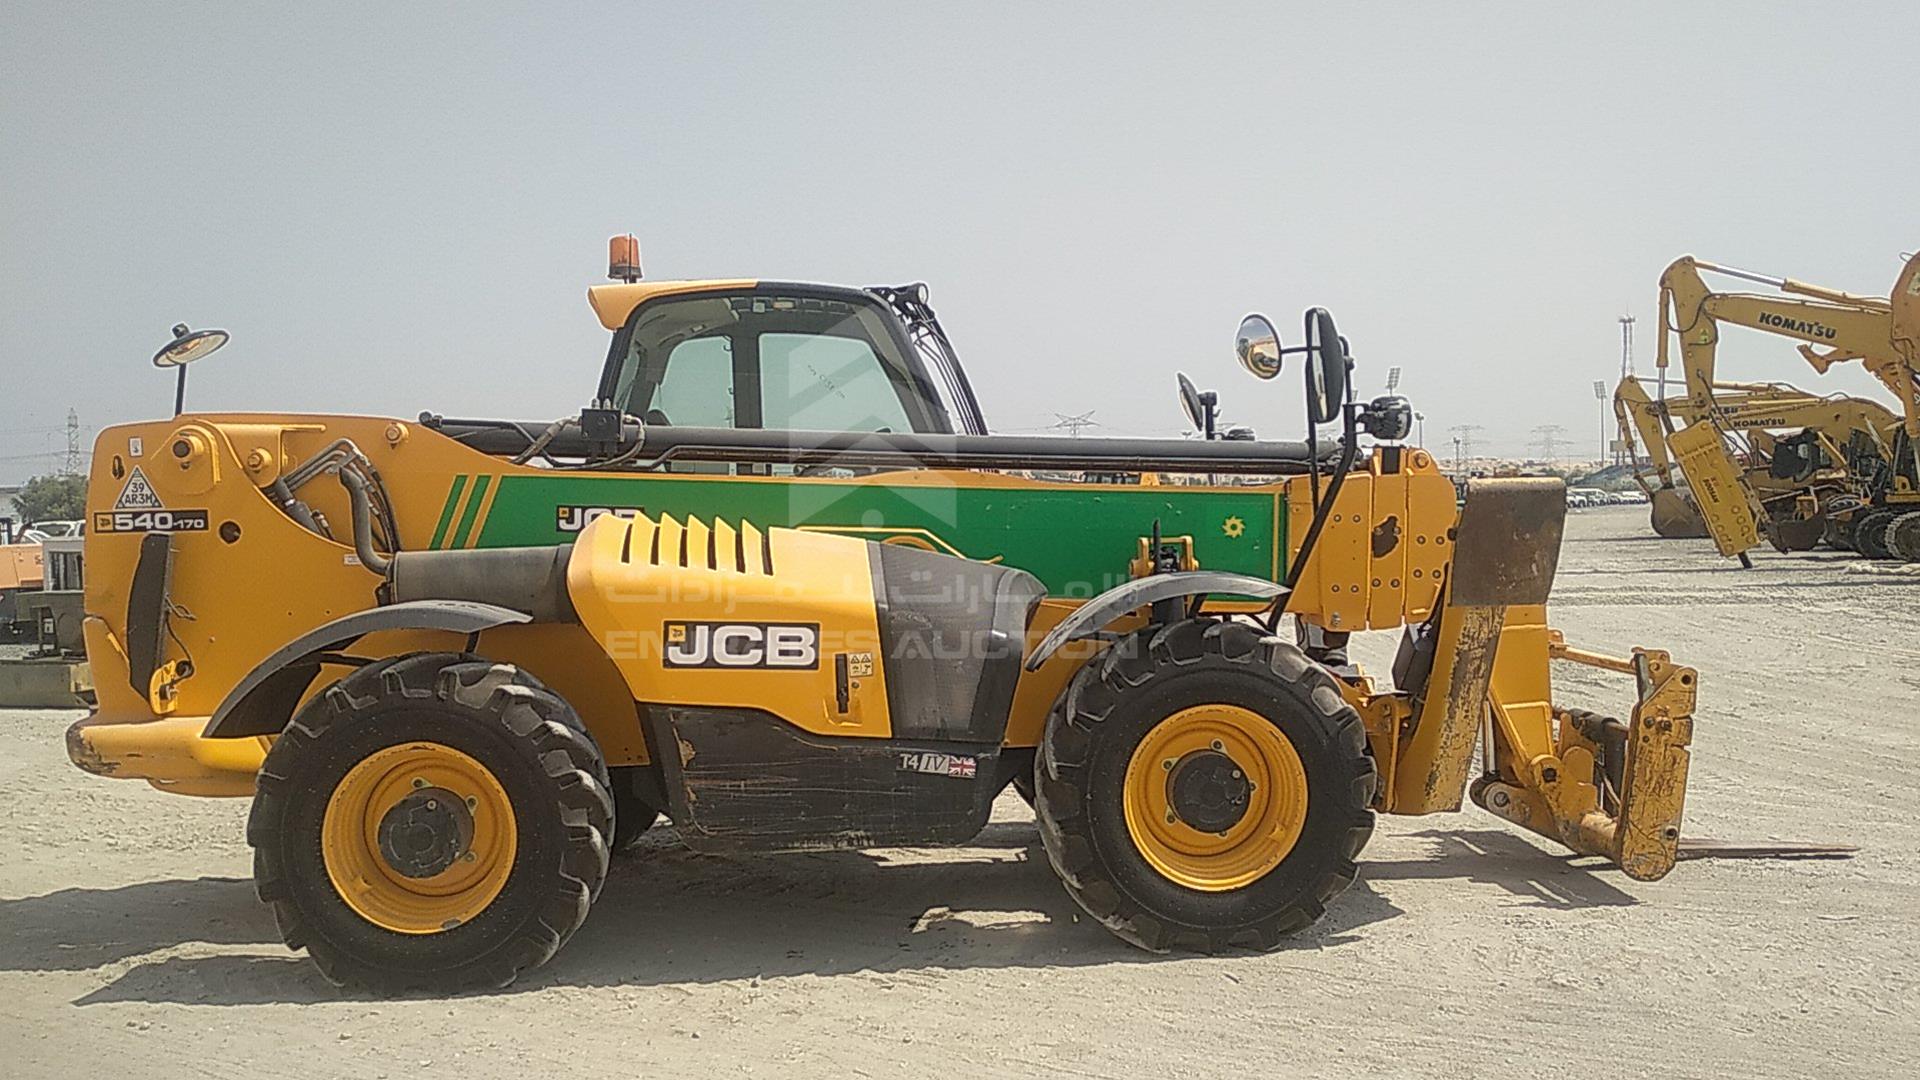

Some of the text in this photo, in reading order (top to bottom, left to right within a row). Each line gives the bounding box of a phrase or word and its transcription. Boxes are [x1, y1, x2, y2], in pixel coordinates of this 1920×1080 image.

[1759, 312, 1837, 339] KOMATSU
[1733, 418, 1786, 427] KOMATSU
[131, 482, 145, 493] 39
[124, 493, 153, 505] AR3M
[667, 624, 817, 667] JCB
